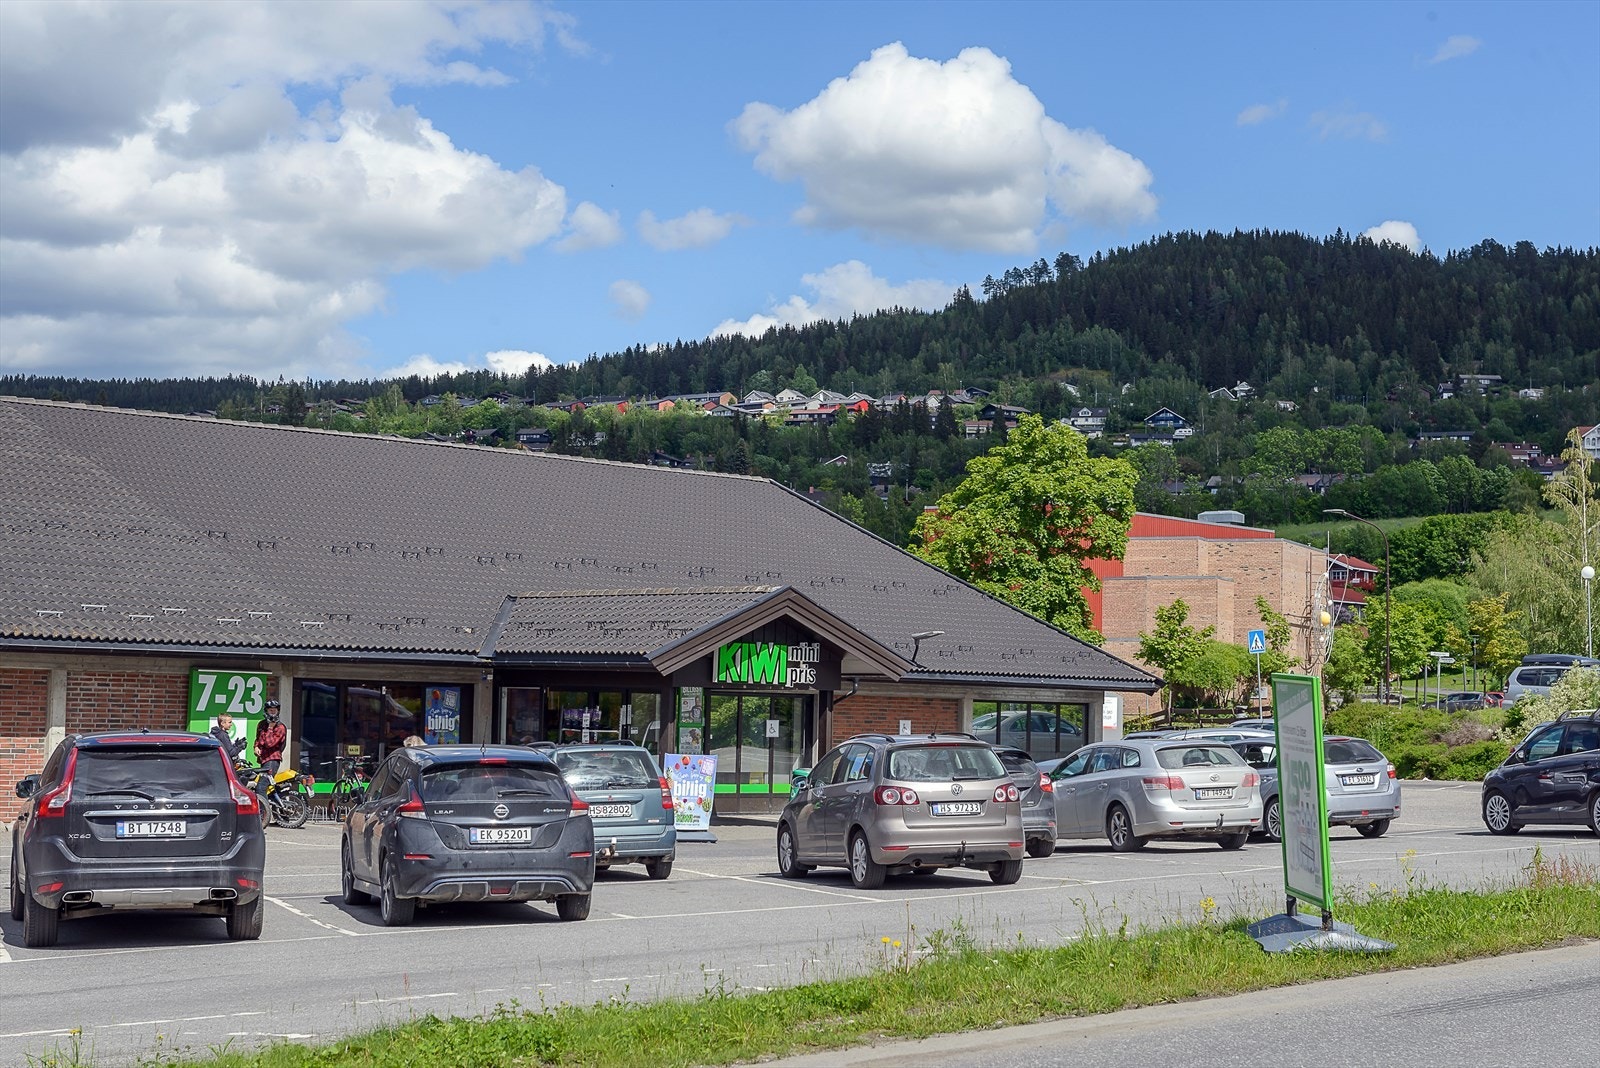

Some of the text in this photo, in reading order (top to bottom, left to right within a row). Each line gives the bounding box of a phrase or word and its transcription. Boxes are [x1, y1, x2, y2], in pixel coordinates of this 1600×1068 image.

[788, 642, 820, 662] mini
[713, 642, 787, 684] KIWI
[785, 664, 816, 687] pris
[196, 674, 263, 714] 7-23
[427, 714, 455, 731] billig
[673, 780, 707, 798] billig
[589, 805, 630, 815] HS82802
[940, 803, 979, 812] HS 97233
[128, 822, 182, 834] BT 17548
[480, 829, 528, 840] EK 95201
